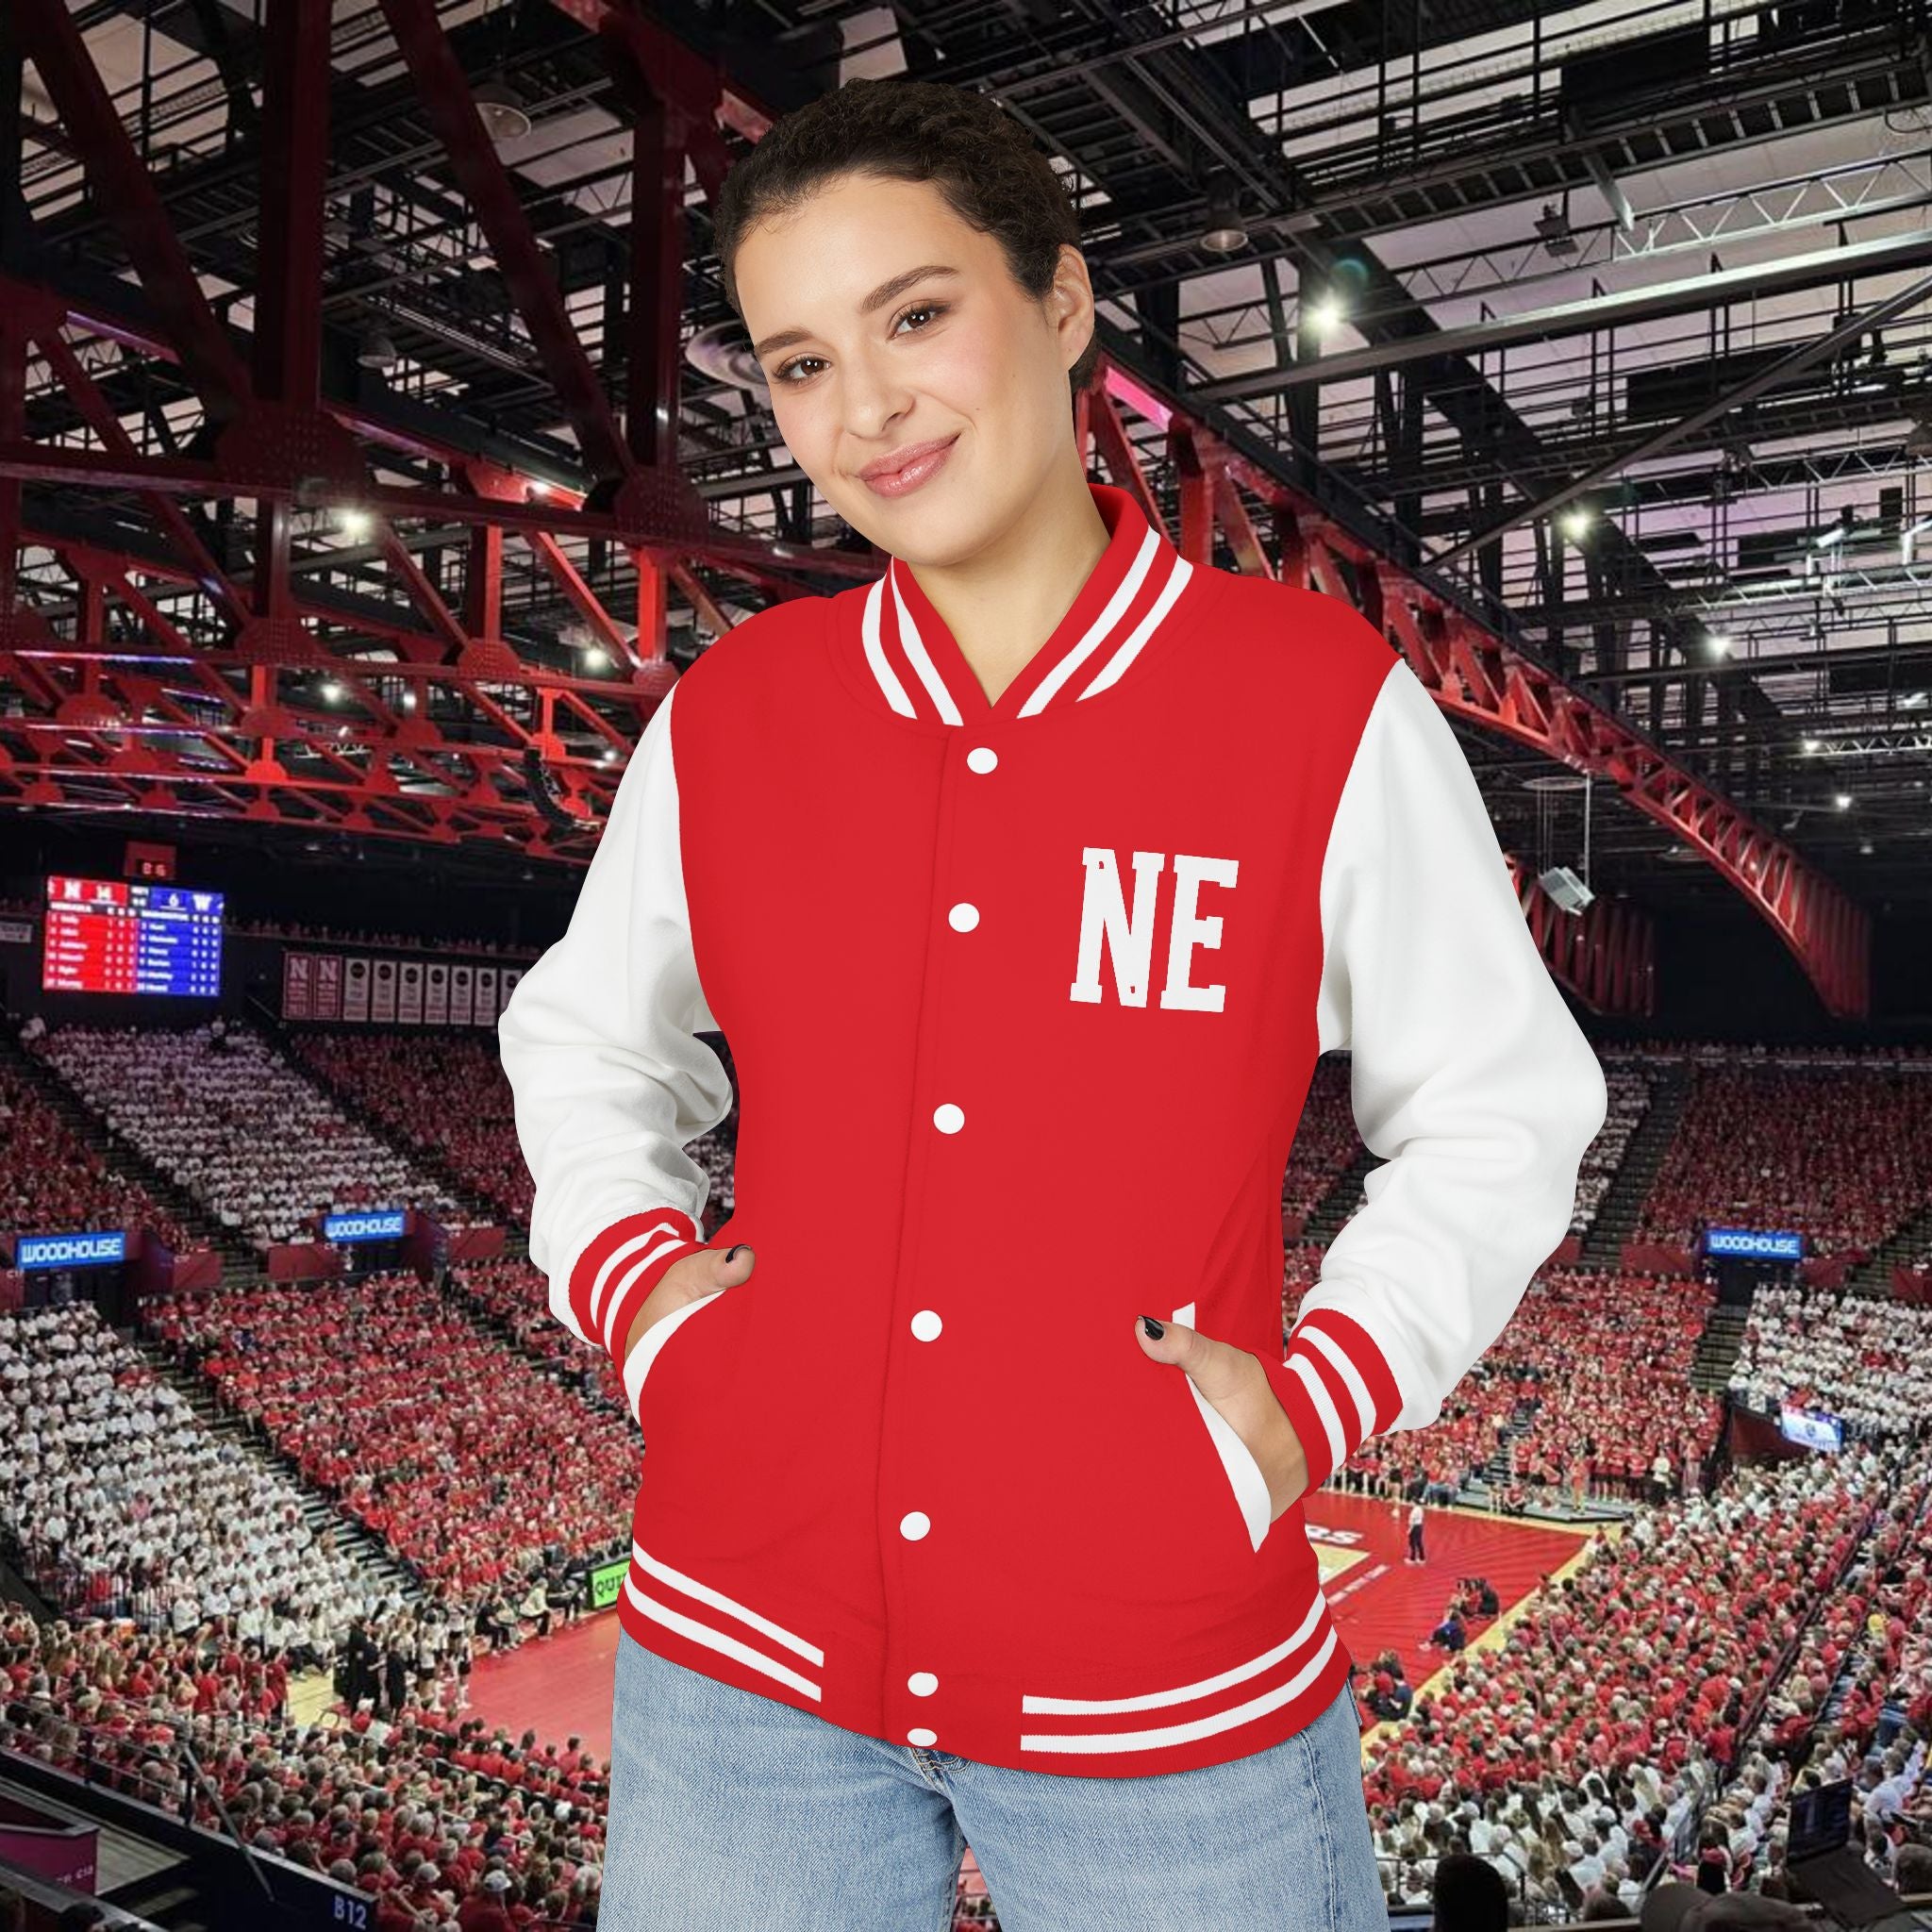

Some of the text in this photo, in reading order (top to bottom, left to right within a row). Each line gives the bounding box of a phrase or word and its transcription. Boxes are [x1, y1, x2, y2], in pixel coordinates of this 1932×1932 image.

[169, 893, 179, 908] 6
[192, 892, 212, 911] W
[1070, 847, 1240, 1013] NE
[290, 957, 308, 980] N
[319, 959, 338, 981] N
[325, 1215, 404, 1239] WOODHOUSE
[22, 1237, 123, 1264] WOODHOUSE
[1709, 1234, 1801, 1256] WOODHOUSE
[334, 1894, 367, 1930] B12
